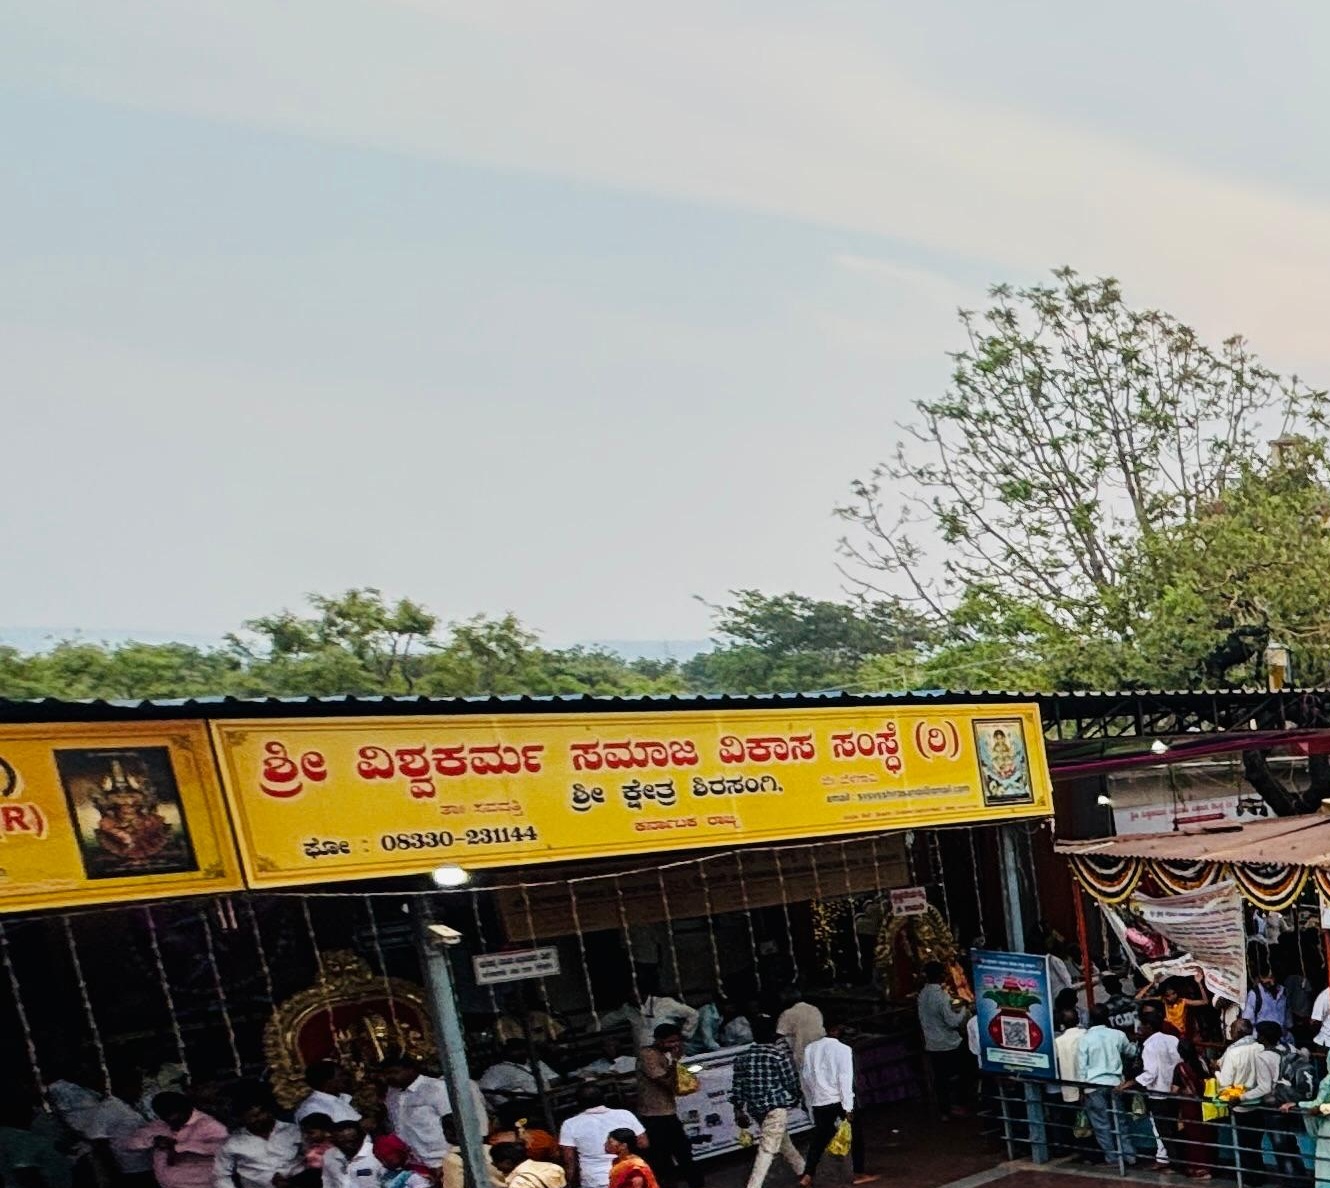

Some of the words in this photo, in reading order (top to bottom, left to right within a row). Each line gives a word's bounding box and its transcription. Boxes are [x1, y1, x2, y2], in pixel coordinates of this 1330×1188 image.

[260, 741, 327, 798] ಶ್ರೀ
[357, 743, 545, 799] ವಿಶ್ವಕರ್ಮ
[570, 738, 699, 771] ಸಮಾಜ
[719, 733, 815, 764] ವಿಕಾಸ
[915, 721, 959, 759] (ರಿ)
[572, 783, 605, 812] ಶ್ರೀ
[622, 779, 677, 810] ಕ್ಷೇತ್ರ
[381, 825, 538, 851] 08330-231144
